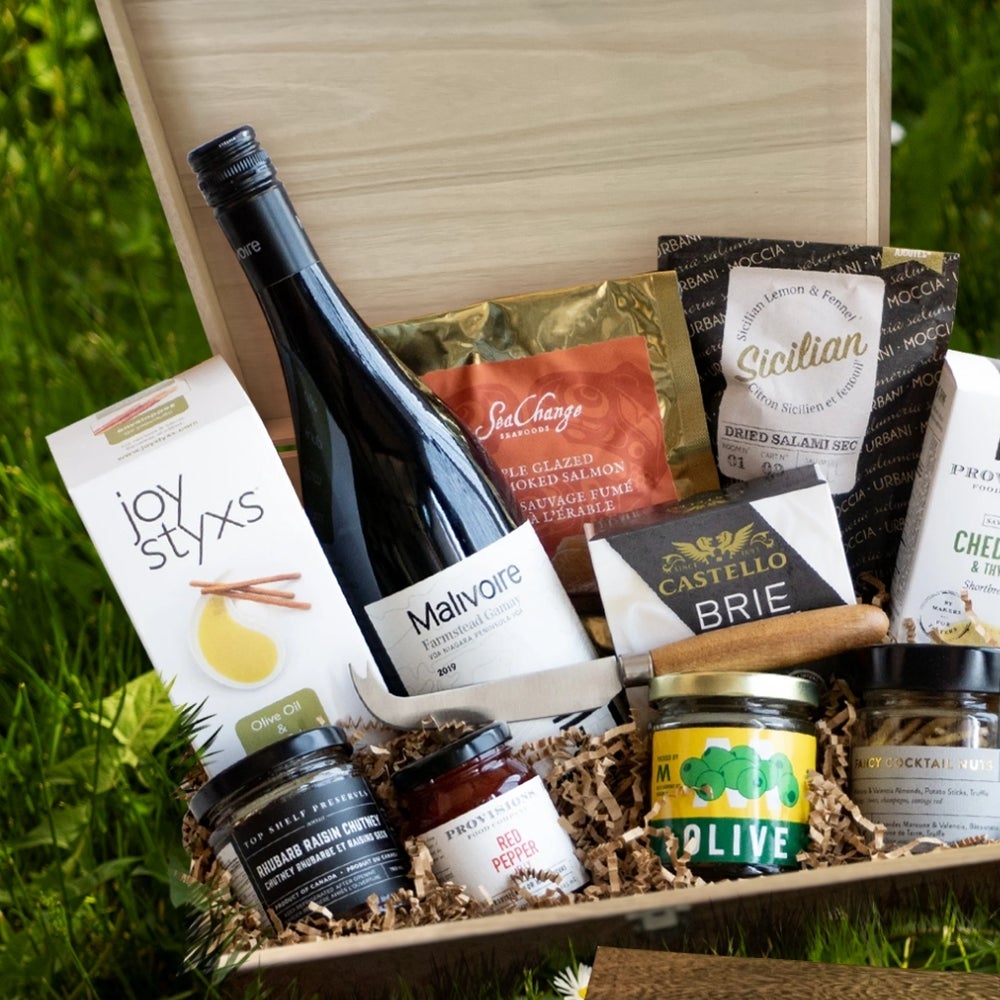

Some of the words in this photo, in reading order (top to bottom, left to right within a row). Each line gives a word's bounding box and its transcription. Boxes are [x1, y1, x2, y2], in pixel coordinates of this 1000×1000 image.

[887, 278, 945, 309] MOCCIA
[737, 301, 765, 342] Sicilian
[764, 285, 805, 304] Lemon
[809, 284, 820, 297] &
[822, 289, 857, 322] Fennel
[734, 331, 868, 382] Sicilian
[748, 382, 778, 410] Citron
[781, 402, 825, 416] Sicilien
[500, 426, 550, 440] SEAFOODS
[724, 425, 769, 444] DRIED
[771, 434, 829, 451] SALAMI
[832, 439, 859, 452] SEC
[865, 424, 913, 453] URBANI
[532, 453, 594, 475] GLAZED
[562, 460, 625, 482] SALMON
[116, 473, 183, 546] joy
[520, 491, 586, 512] SAUVAGE
[591, 479, 633, 499] FUMÉ
[140, 490, 264, 570] styxs
[658, 552, 788, 596] CASTELLO
[971, 560, 979, 573] &
[406, 563, 523, 636] Malivoire
[695, 581, 791, 630] BRIE
[421, 614, 484, 651] Farmstead
[442, 635, 473, 655] NIAGARA
[437, 662, 457, 677] 2019
[250, 712, 281, 733] Olive
[283, 700, 302, 716] Oil
[276, 722, 288, 736] &
[886, 757, 953, 770] COCKTAIL
[959, 758, 993, 772] NUTS
[925, 787, 946, 795] Potato
[243, 831, 264, 850] TOP
[268, 809, 307, 835] SHELF
[445, 789, 537, 841] PROVISIONS
[255, 843, 303, 879] RHUBARB
[303, 825, 342, 852] RAISIN
[341, 813, 382, 836] CHUTNEY
[496, 828, 522, 851] RED
[683, 823, 789, 859] OLIVE
[264, 866, 296, 891] CHUTNEY
[297, 846, 336, 873] RHUBARBE
[336, 842, 347, 854] ET
[347, 833, 377, 849] RAISINS
[491, 840, 539, 873] PEPPER
[300, 886, 310, 895] OF
[310, 873, 338, 890] CANADA
